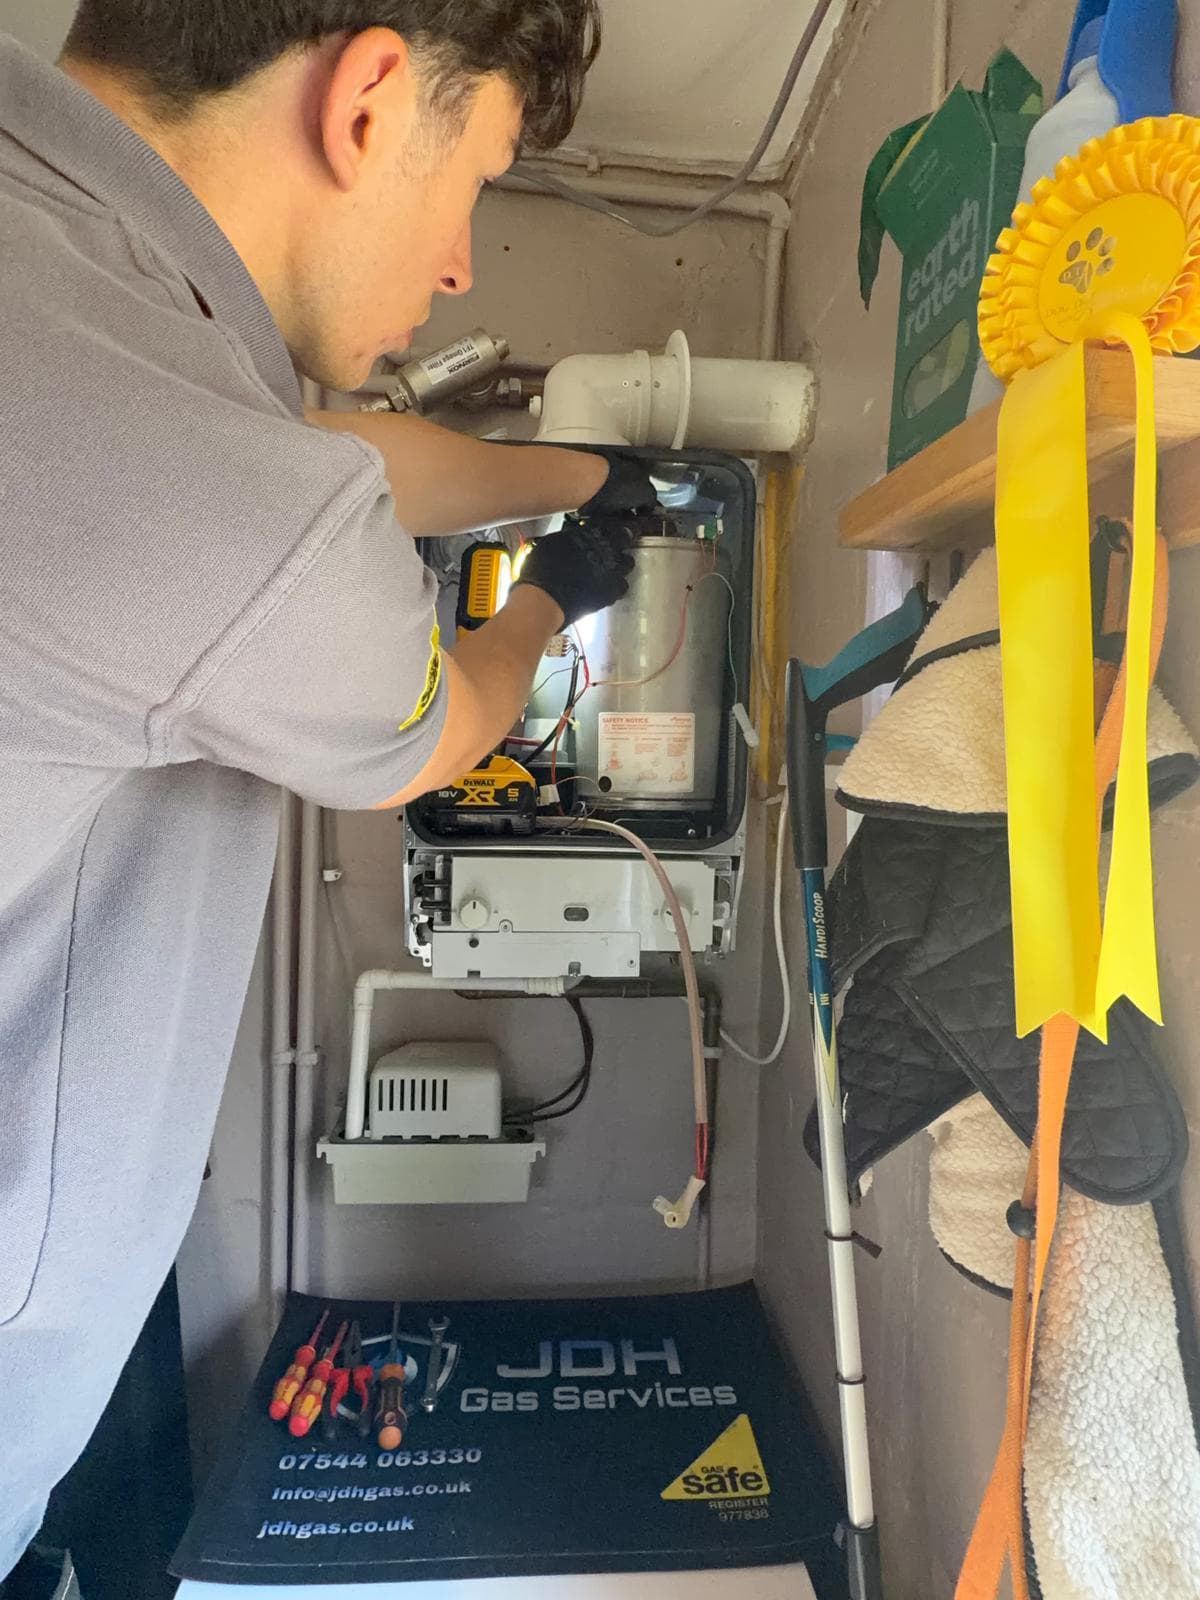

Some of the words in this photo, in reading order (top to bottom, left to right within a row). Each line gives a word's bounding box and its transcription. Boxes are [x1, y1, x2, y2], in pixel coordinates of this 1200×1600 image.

[908, 198, 979, 301] earth
[905, 234, 976, 346] rated
[507, 788, 519, 797] 5
[496, 1338, 682, 1378] JDH
[460, 1387, 540, 1413] Gas
[552, 1382, 738, 1410] Services
[278, 1452, 368, 1470] 07544
[376, 1448, 482, 1468] 063330
[701, 1466, 724, 1474] GAS
[681, 1466, 763, 1495] safe
[708, 1498, 768, 1510] REGISTER
[256, 1515, 416, 1540] jdhgas.co.uk
